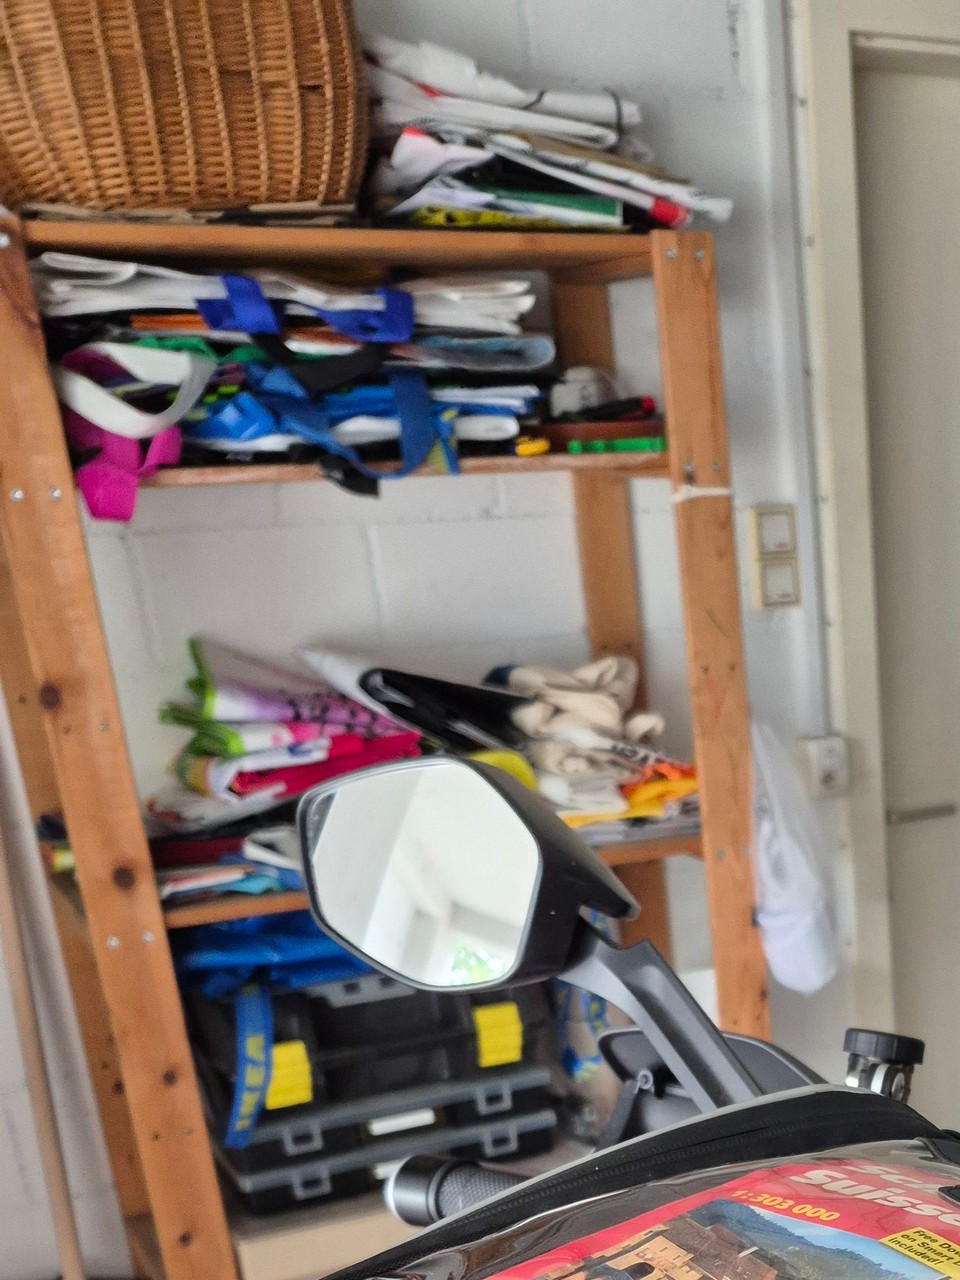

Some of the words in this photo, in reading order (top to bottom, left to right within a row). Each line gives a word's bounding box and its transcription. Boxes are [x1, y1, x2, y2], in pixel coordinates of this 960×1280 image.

[900, 1234, 917, 1243] on
[917, 1242, 954, 1262] Smart
[913, 1229, 939, 1244] Free
[888, 1237, 944, 1266] included!
